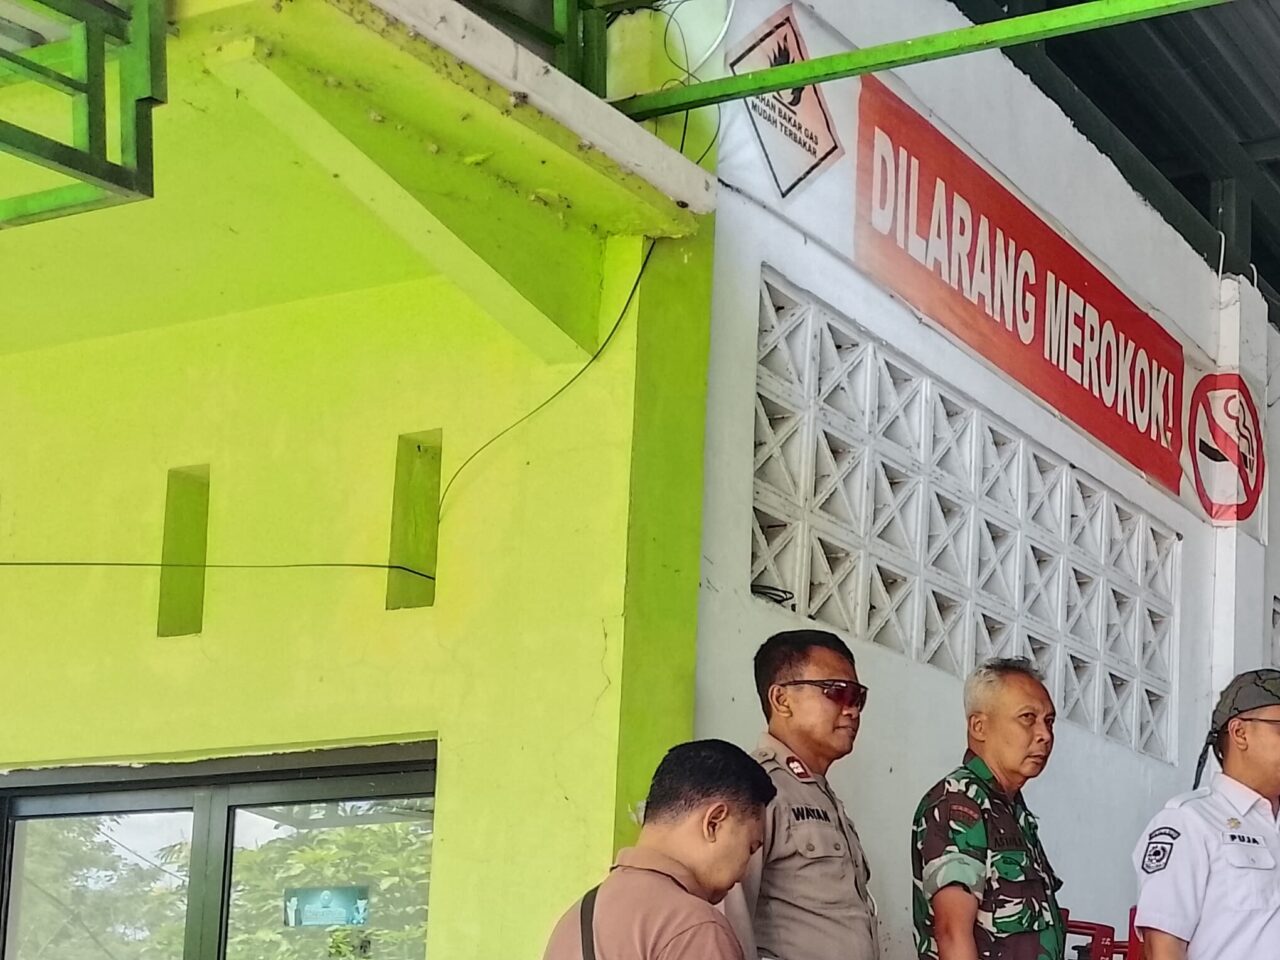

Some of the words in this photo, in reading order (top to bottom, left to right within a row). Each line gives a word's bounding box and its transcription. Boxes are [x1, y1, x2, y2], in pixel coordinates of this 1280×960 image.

[751, 99, 778, 128] MUDAH
[779, 121, 818, 158] TERBAKAR
[777, 107, 803, 133] BAKAR
[803, 126, 819, 146] GAS
[871, 126, 1036, 345] DILARANG
[1044, 269, 1175, 452] MEROKOK!
[791, 806, 831, 822] WAYAN
[1229, 834, 1260, 845] PUJA
